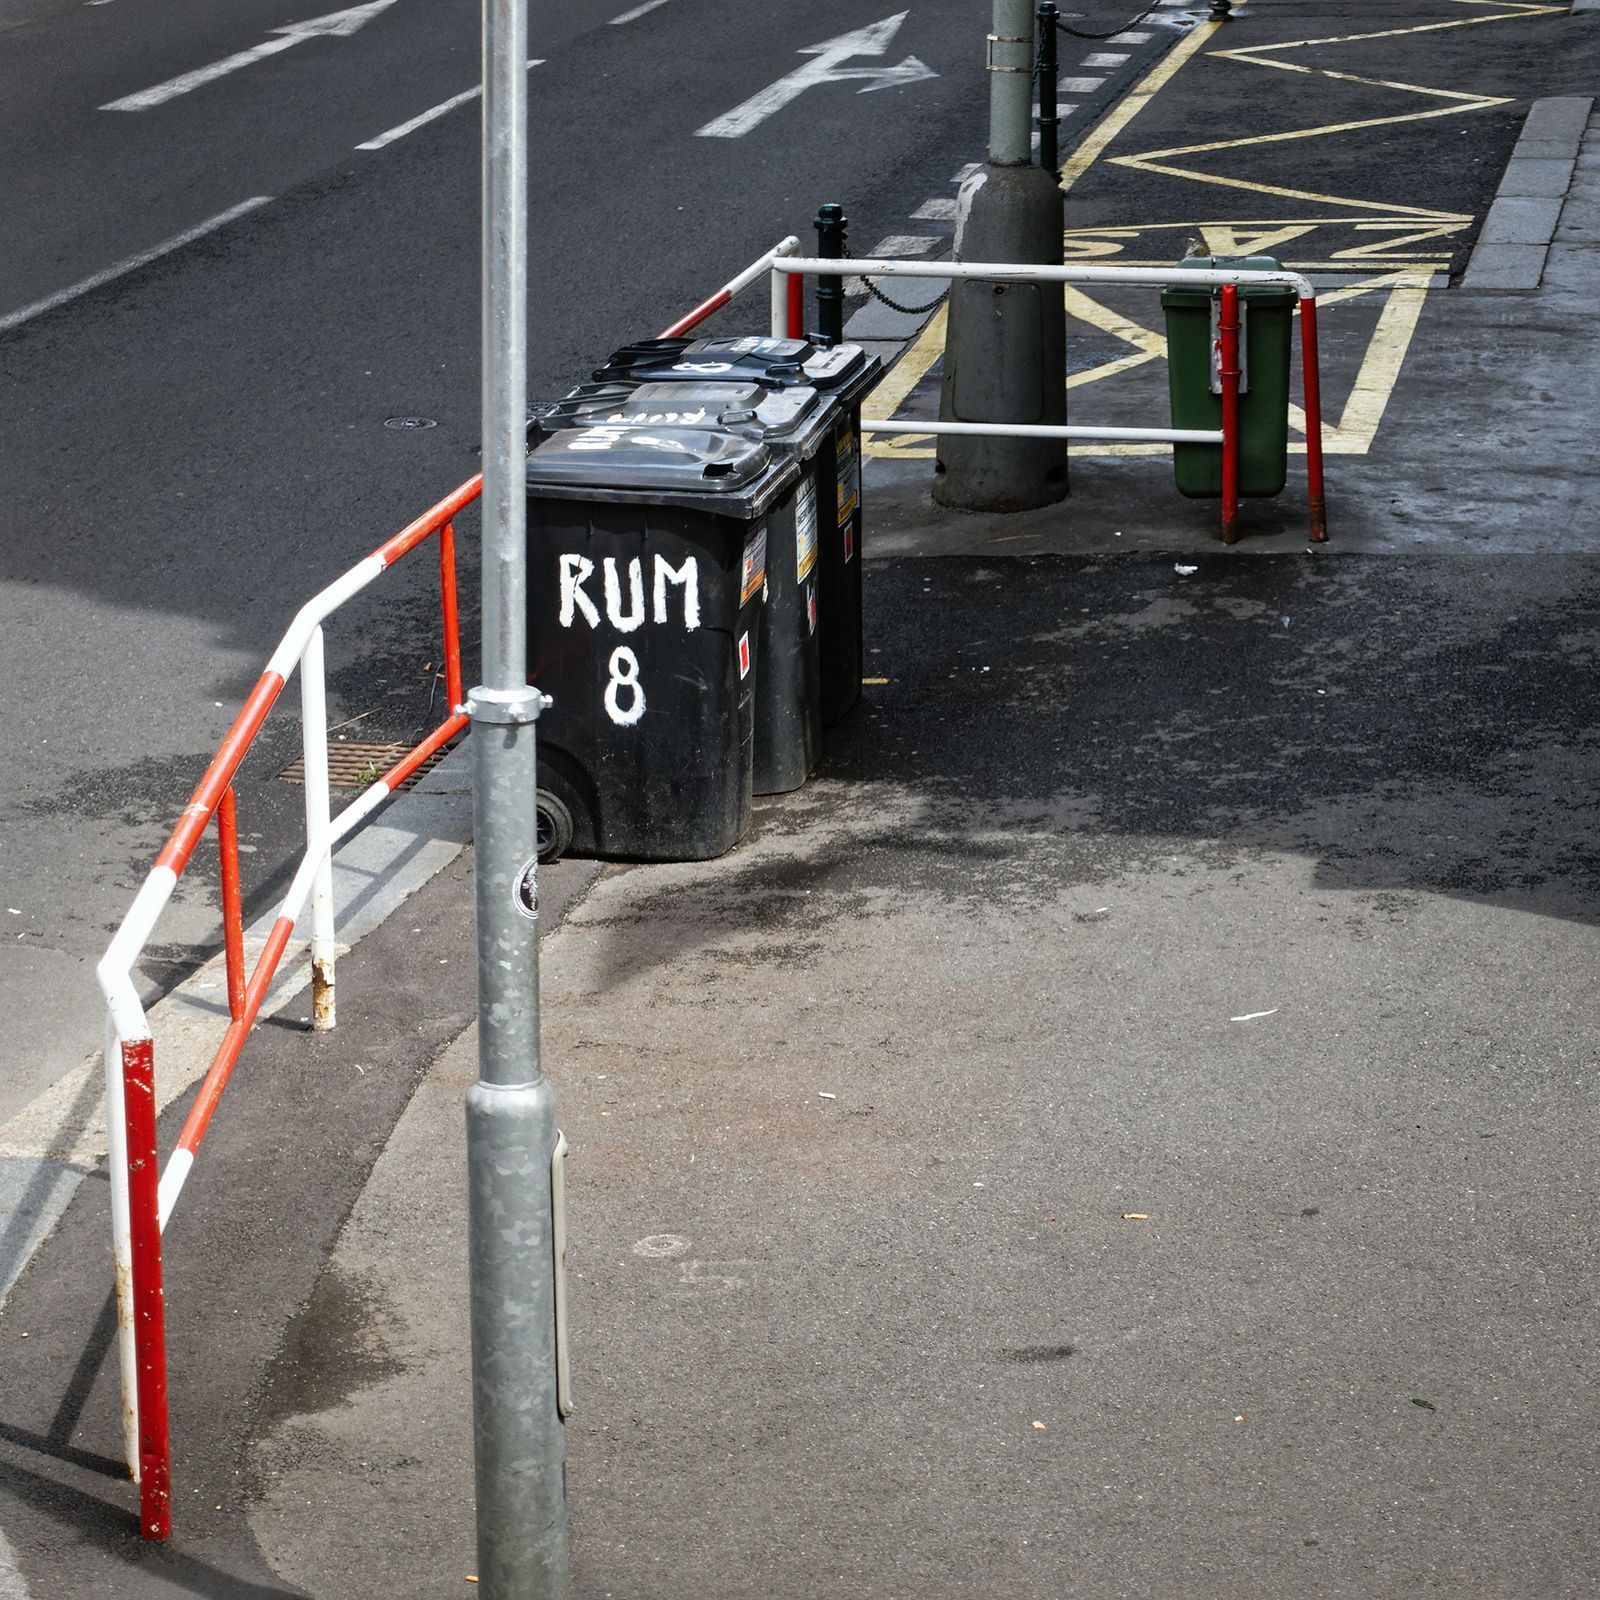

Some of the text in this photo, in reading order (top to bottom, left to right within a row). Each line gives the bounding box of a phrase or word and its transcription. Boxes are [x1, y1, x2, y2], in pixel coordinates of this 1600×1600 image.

[672, 362, 733, 374] 8
[559, 553, 701, 632] RUM
[604, 645, 647, 727] 8
